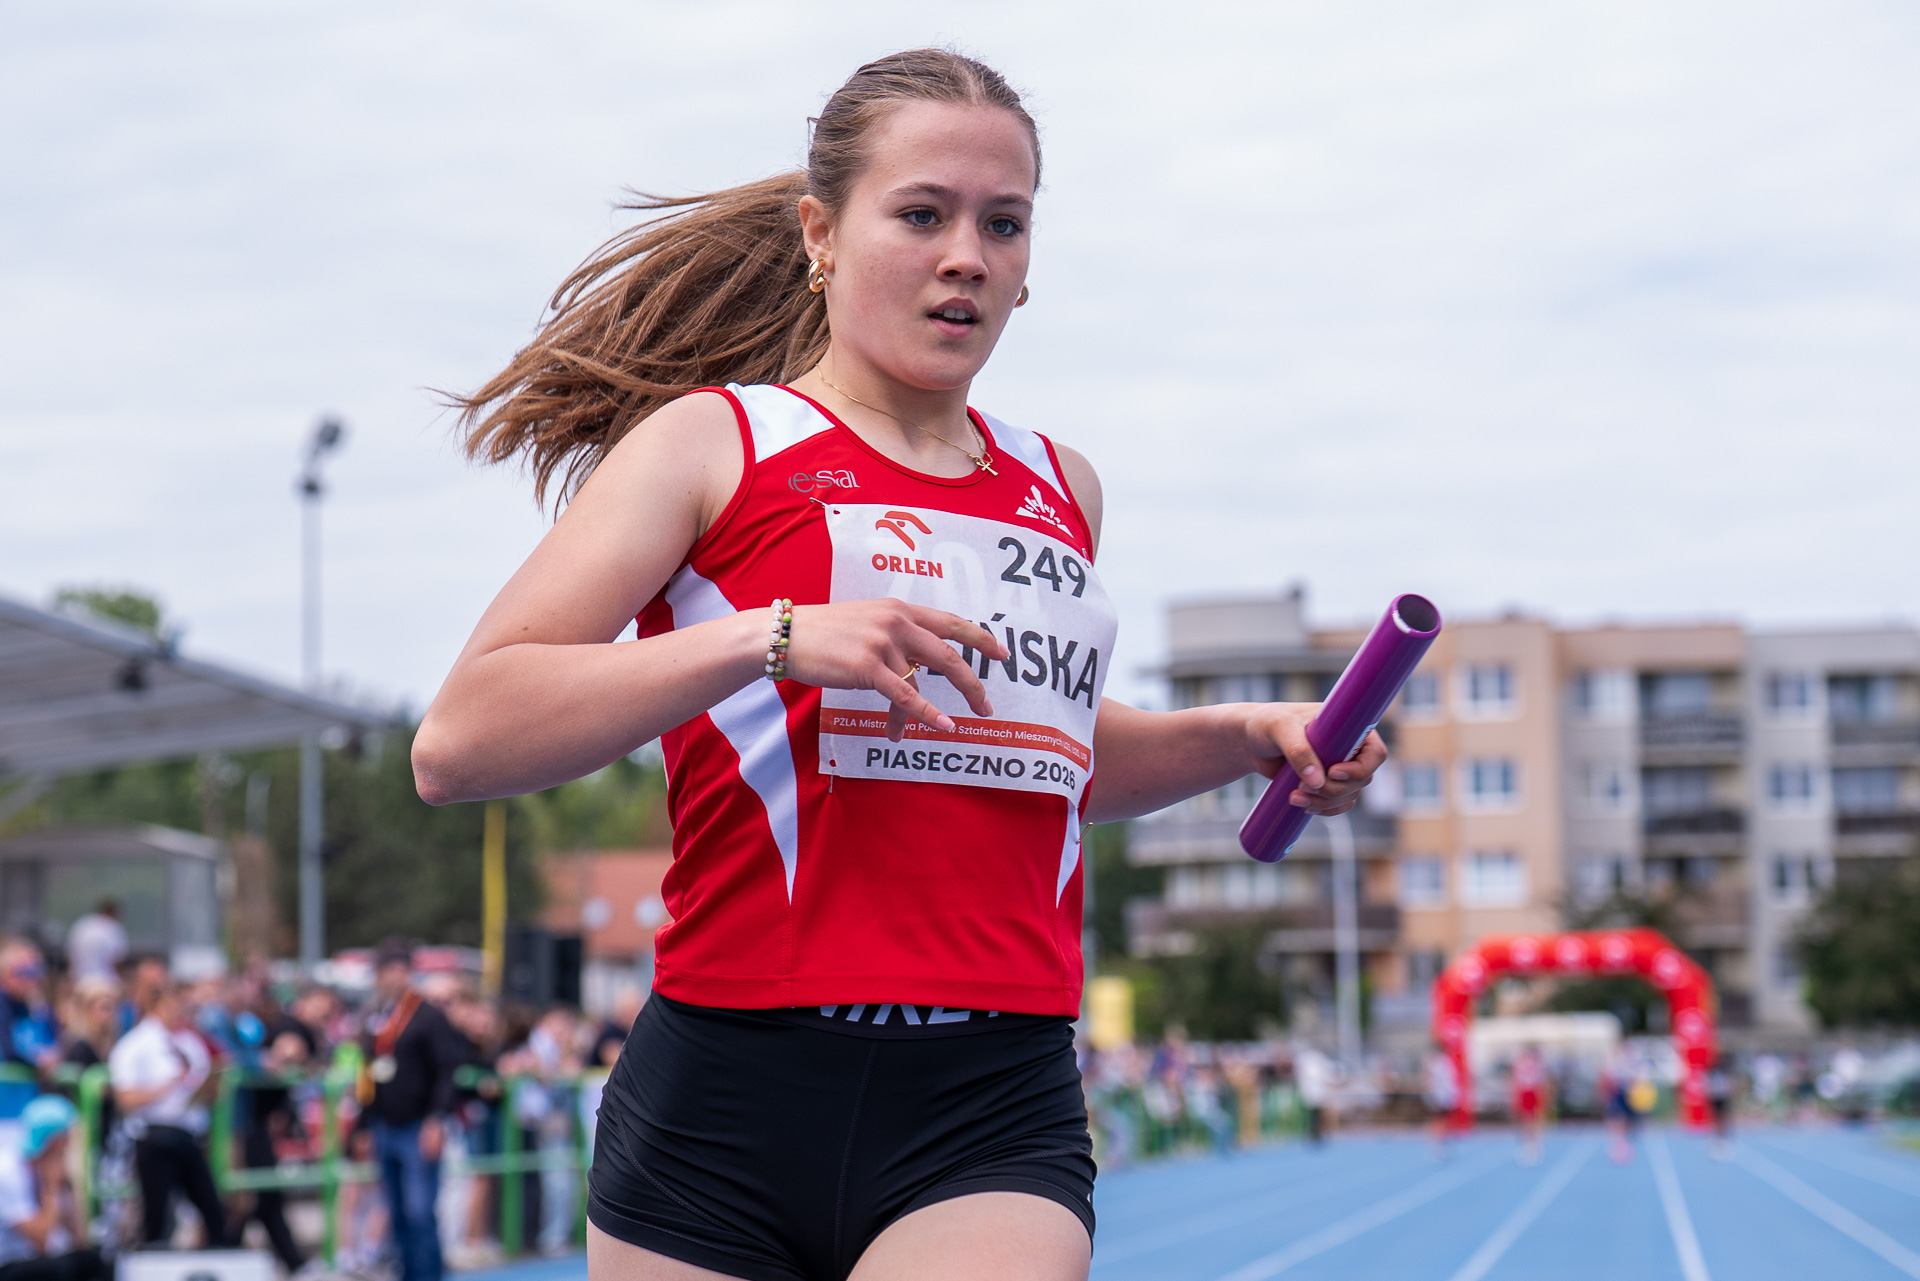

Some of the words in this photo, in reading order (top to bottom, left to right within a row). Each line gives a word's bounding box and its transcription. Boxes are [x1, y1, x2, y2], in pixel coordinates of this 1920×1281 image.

[871, 553, 944, 579] ORLEN
[998, 536, 1086, 599] 249
[833, 717, 857, 727] PZLA
[859, 719, 916, 731] Mistrzwa
[958, 725, 1013, 739] Sztafetach
[866, 747, 1026, 778] PIASECZNO
[1032, 760, 1076, 790] 2026
